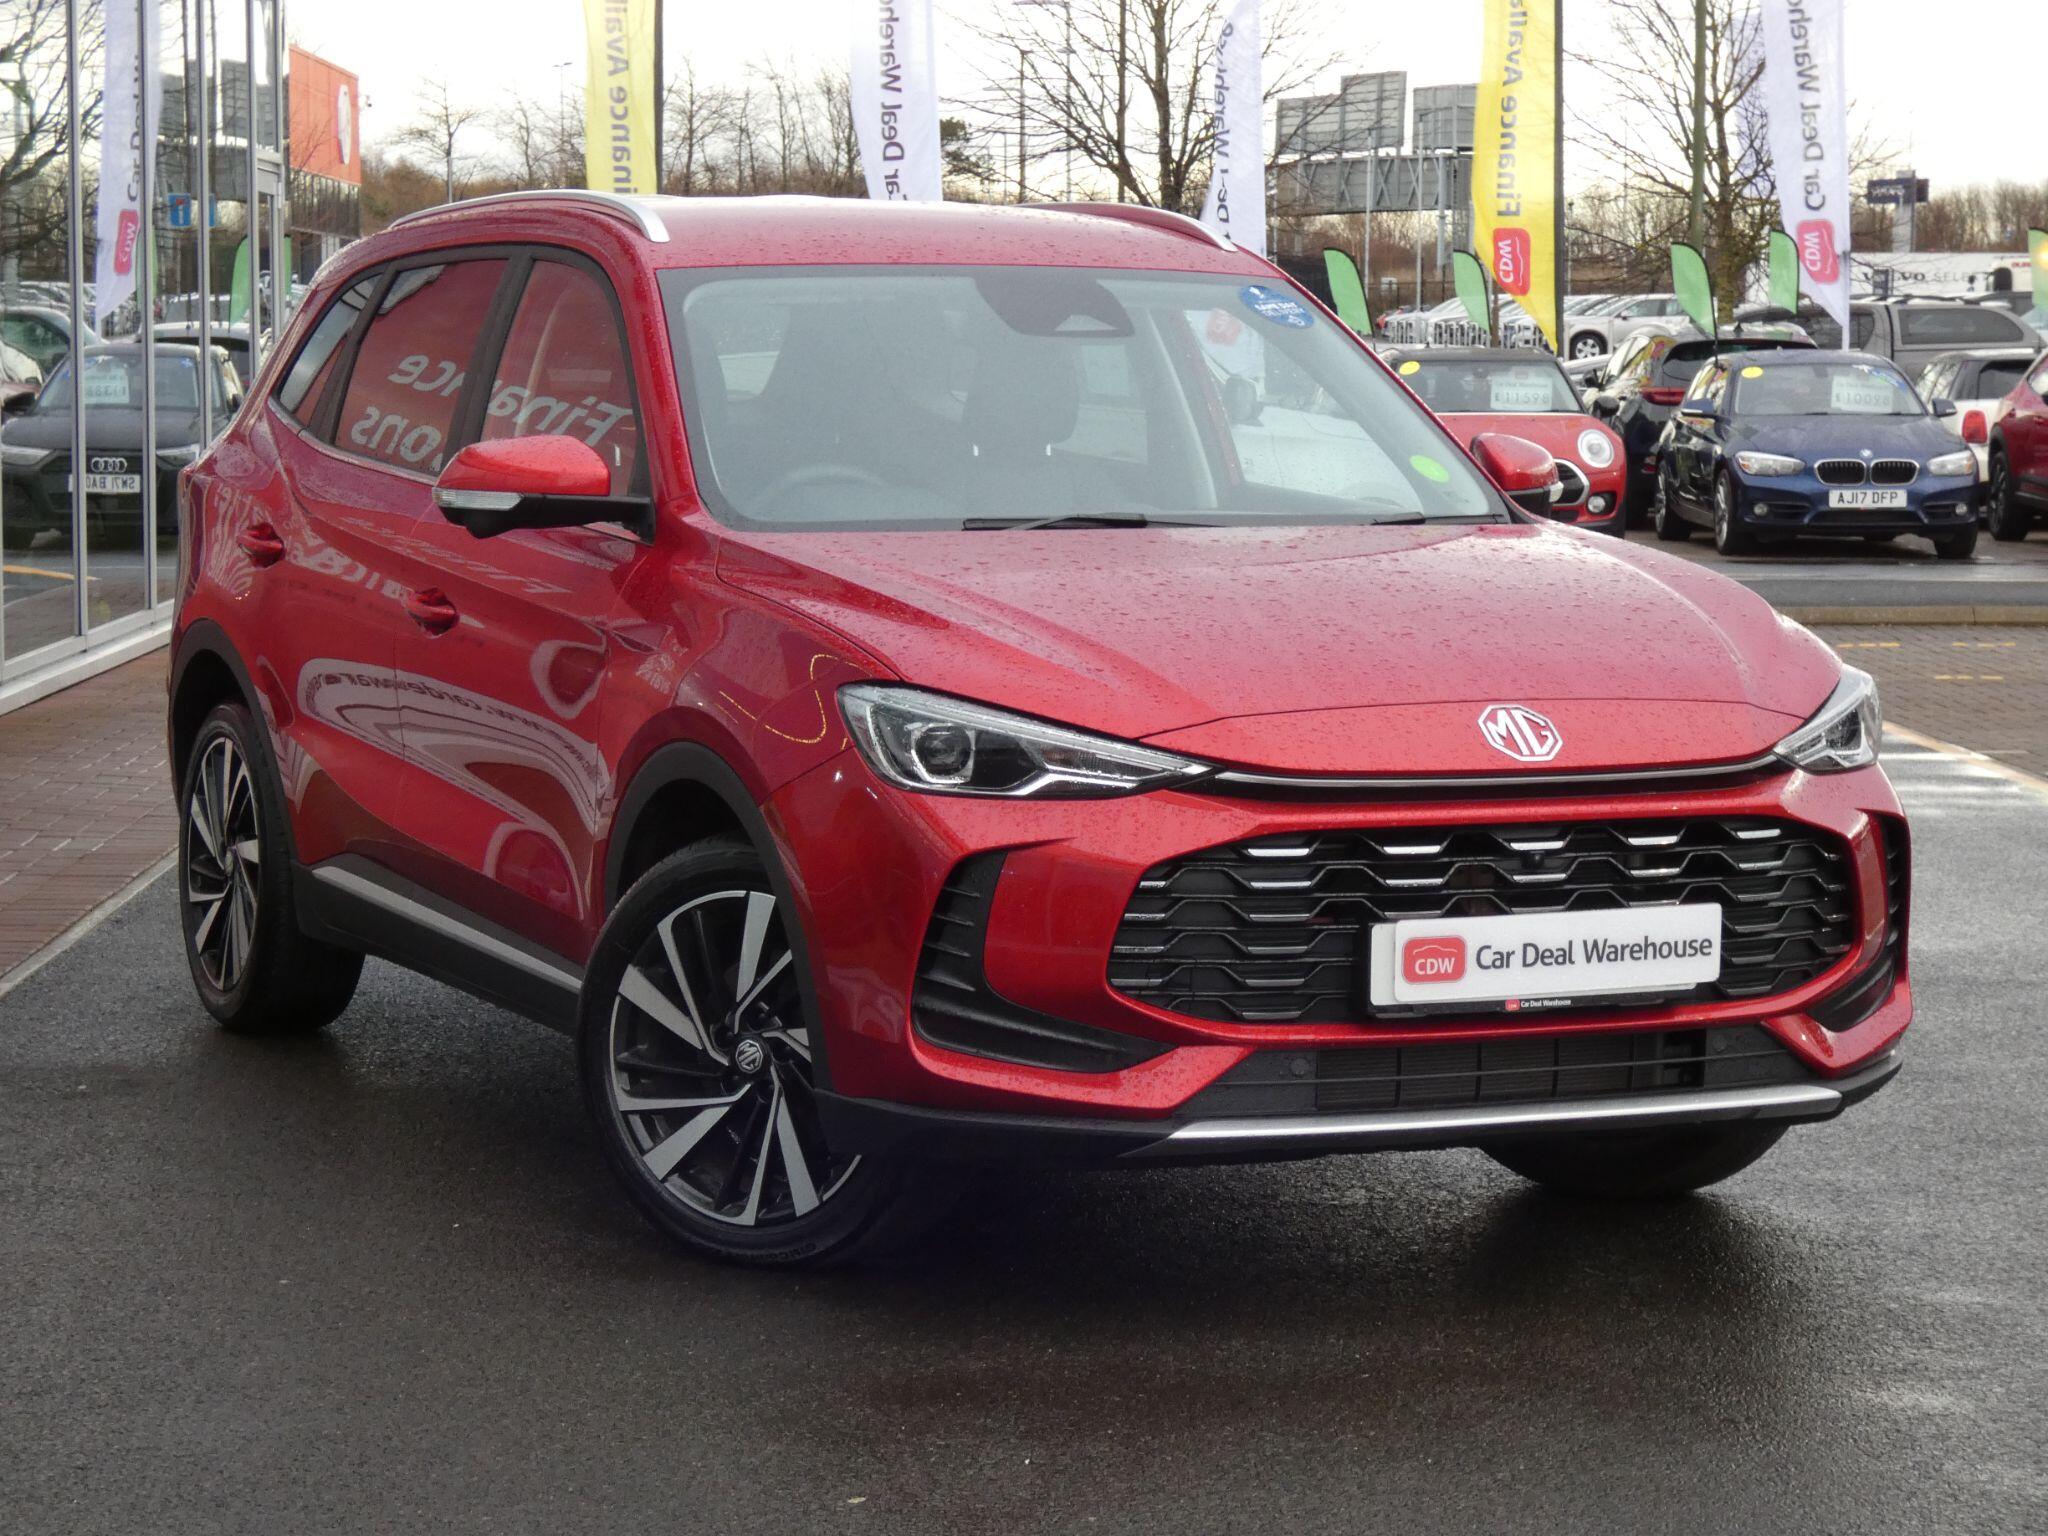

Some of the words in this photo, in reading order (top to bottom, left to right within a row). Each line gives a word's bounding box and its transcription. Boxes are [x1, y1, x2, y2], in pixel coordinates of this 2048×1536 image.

[1837, 491, 1867, 505] AJ17
[1872, 491, 1898, 505] DFP
[1485, 708, 1555, 756] MG
[1414, 957, 1455, 976] CDW
[1475, 944, 1516, 971] Car
[1522, 940, 1575, 968] Deal
[1583, 936, 1713, 963] Warehouse
[738, 1042, 760, 1070] MG
